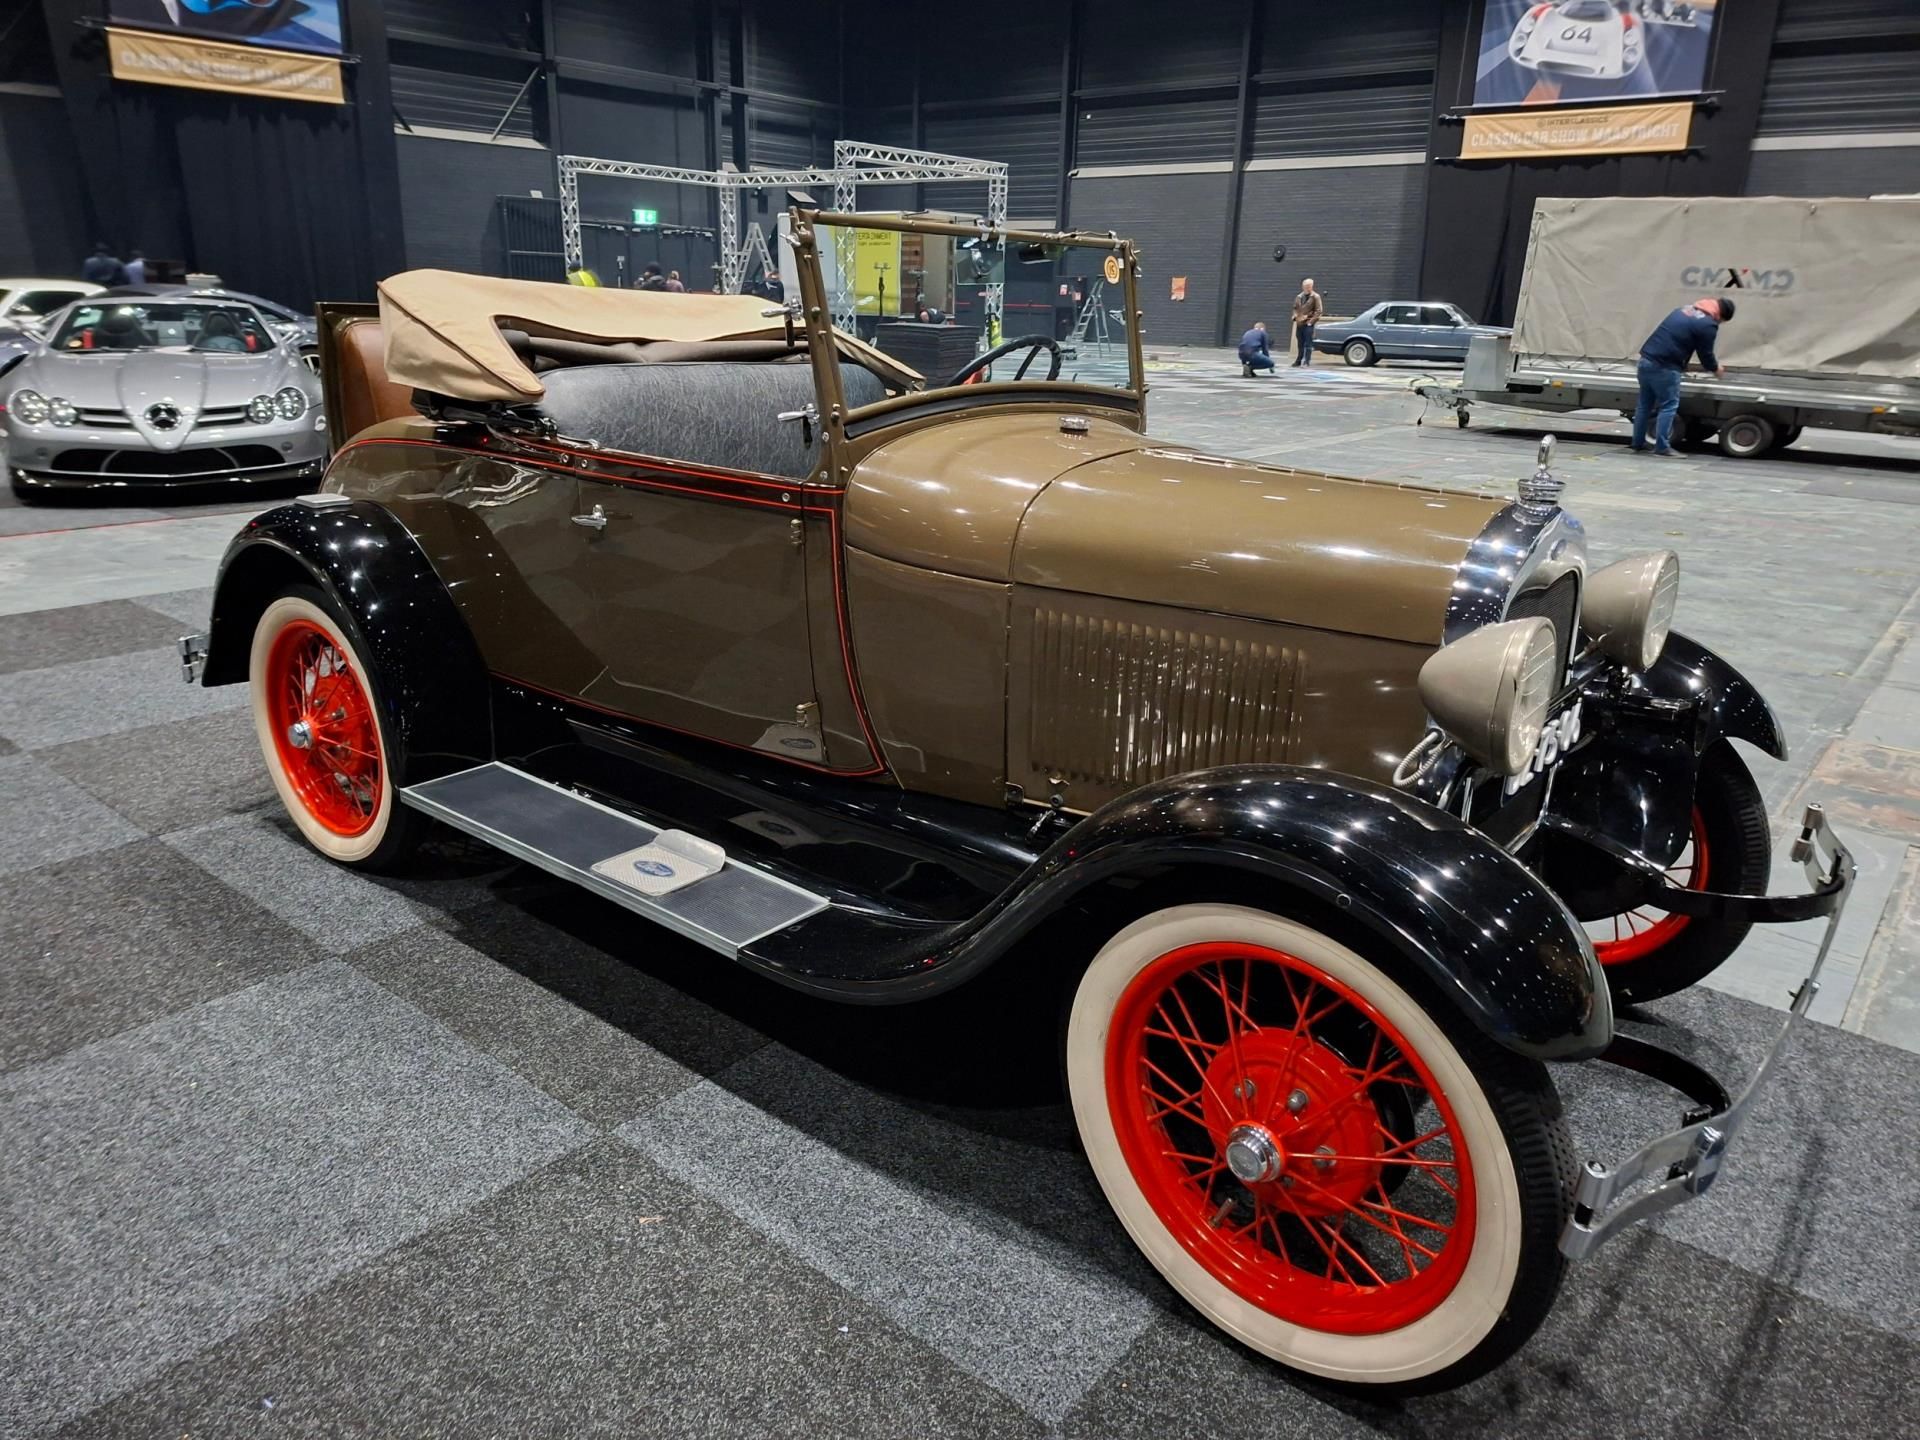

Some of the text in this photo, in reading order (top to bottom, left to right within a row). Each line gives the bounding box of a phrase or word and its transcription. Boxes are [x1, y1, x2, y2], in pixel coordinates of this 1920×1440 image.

[1560, 25, 1593, 44] 64
[1471, 131, 1521, 147] CLASSIC
[1522, 129, 1549, 145] CAR
[1550, 127, 1586, 145] SHOW
